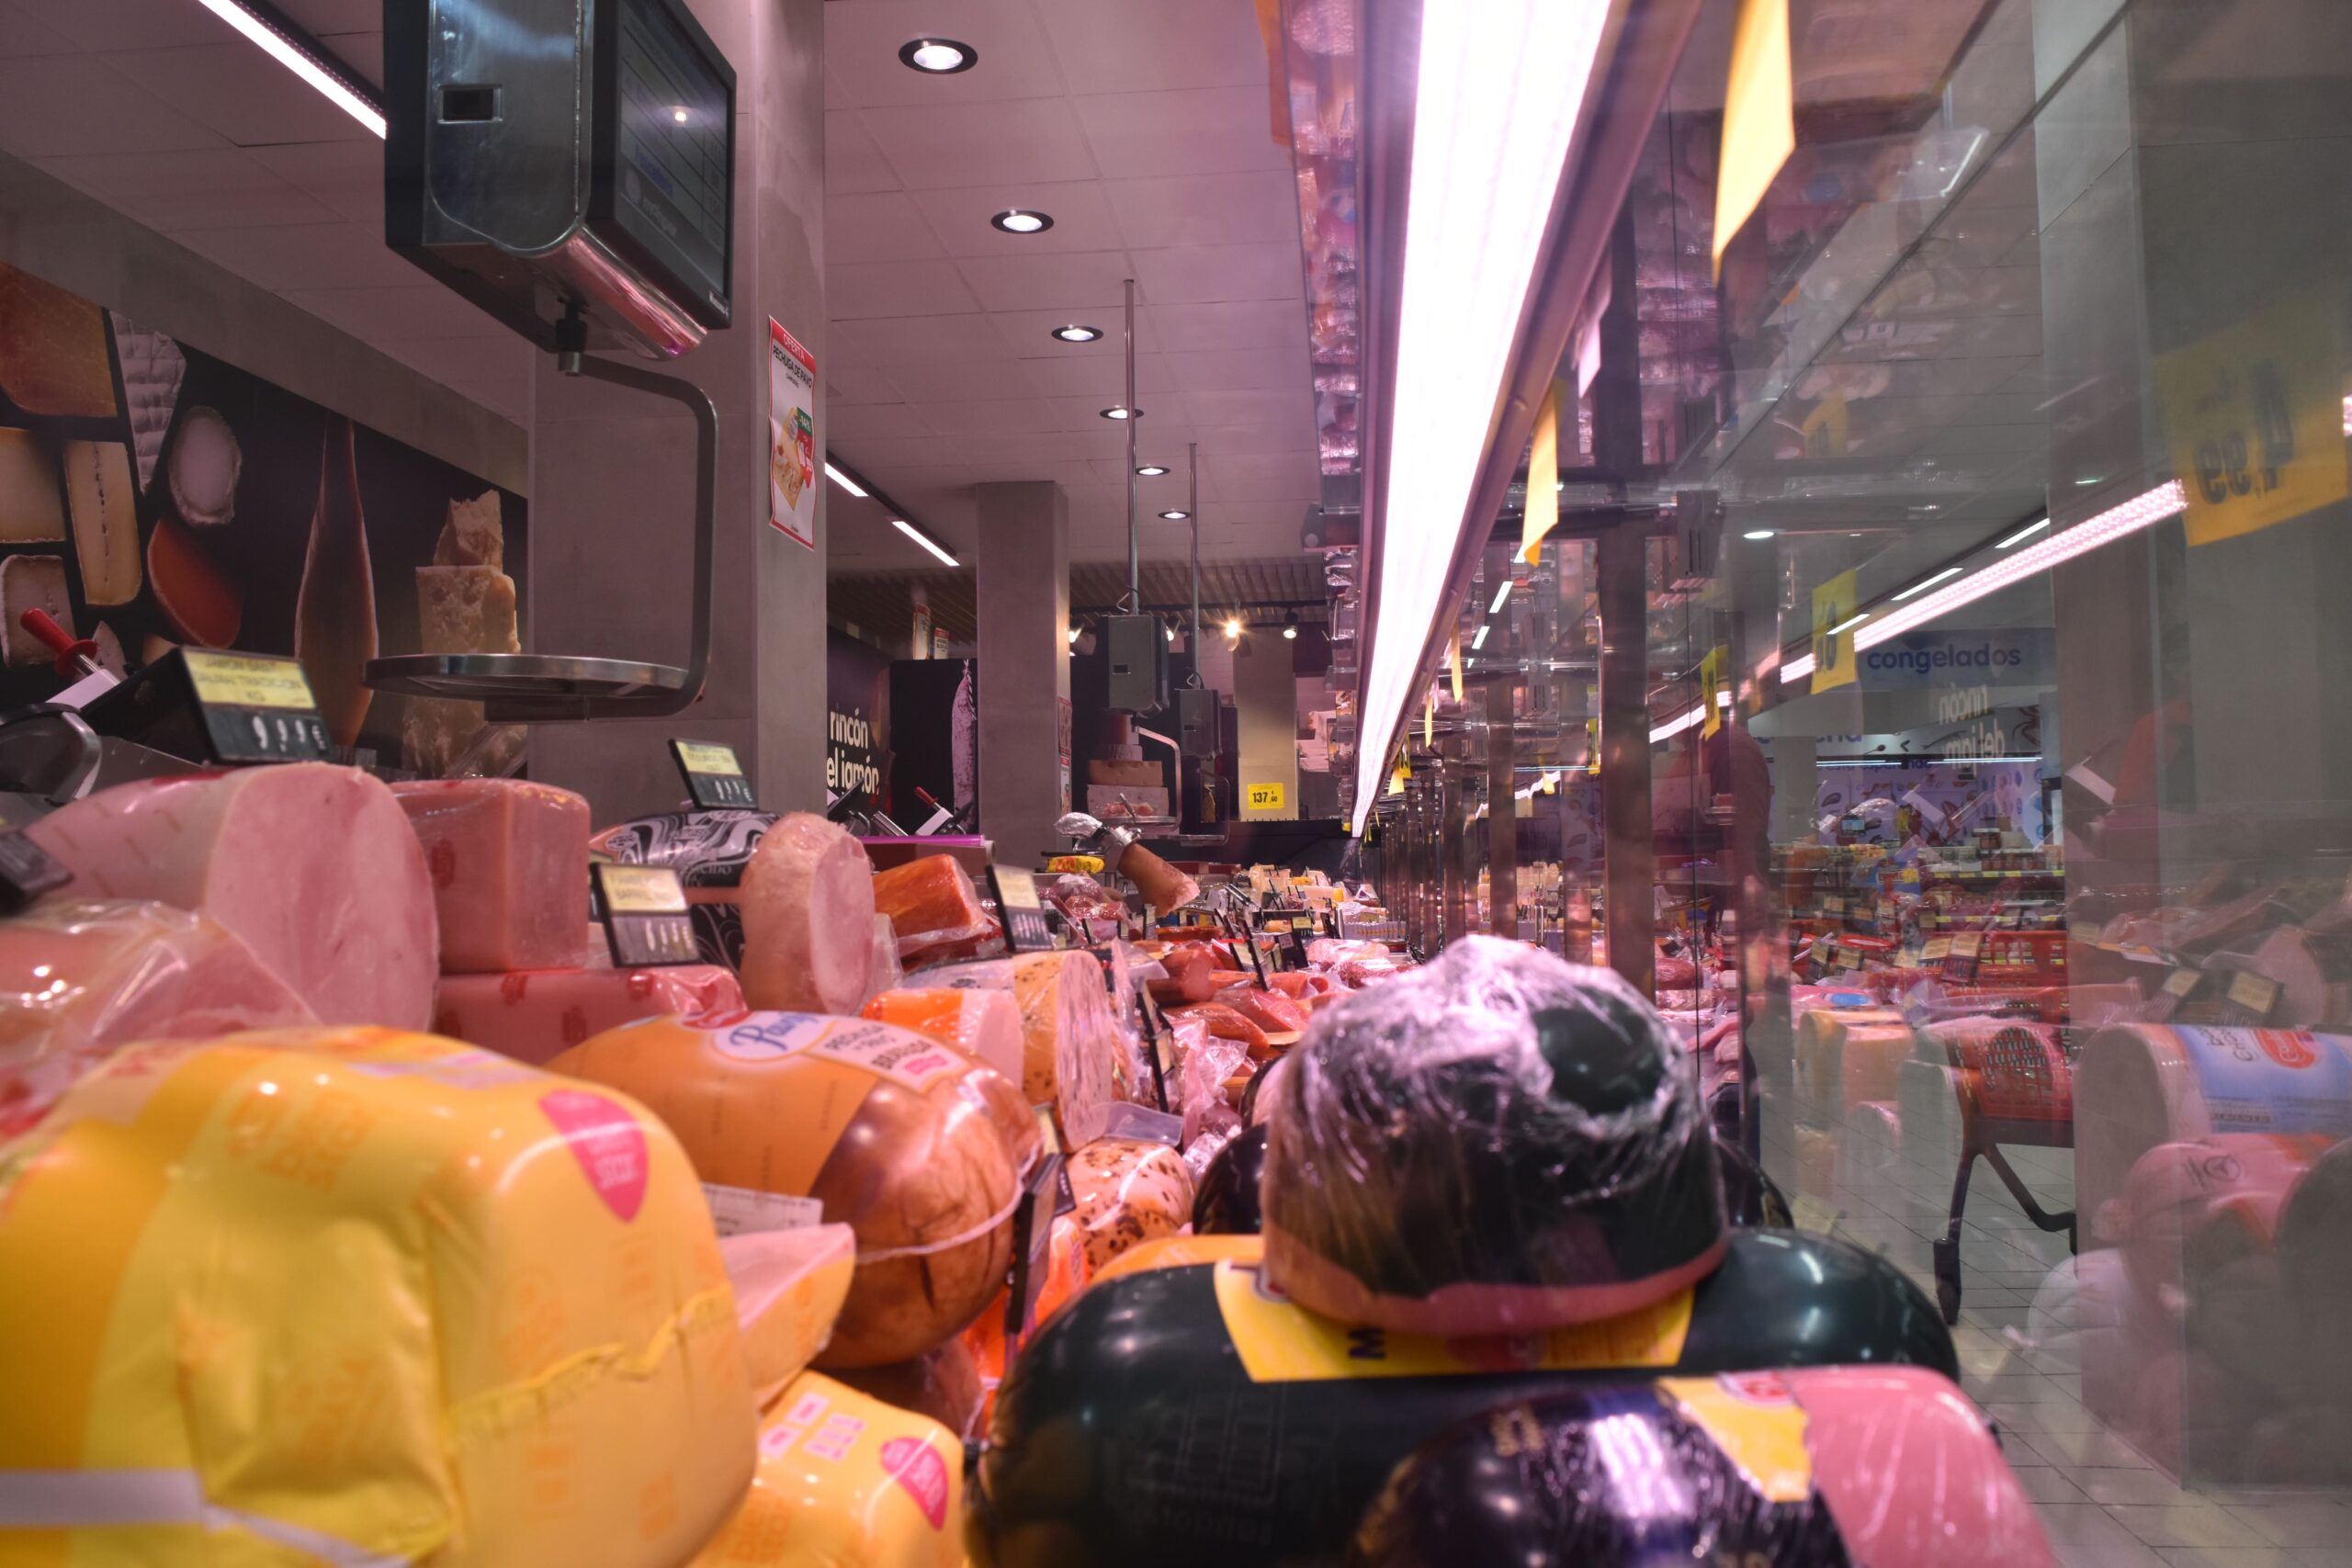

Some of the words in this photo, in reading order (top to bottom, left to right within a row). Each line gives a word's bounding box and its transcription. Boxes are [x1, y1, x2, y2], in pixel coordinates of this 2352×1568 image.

[773, 344, 794, 370] PECHUGA
[784, 333, 806, 362] OFERTA
[1867, 644, 2021, 674] congelados
[831, 707, 868, 750] rincón
[827, 747, 838, 788] el
[1252, 792, 1268, 803] 137
